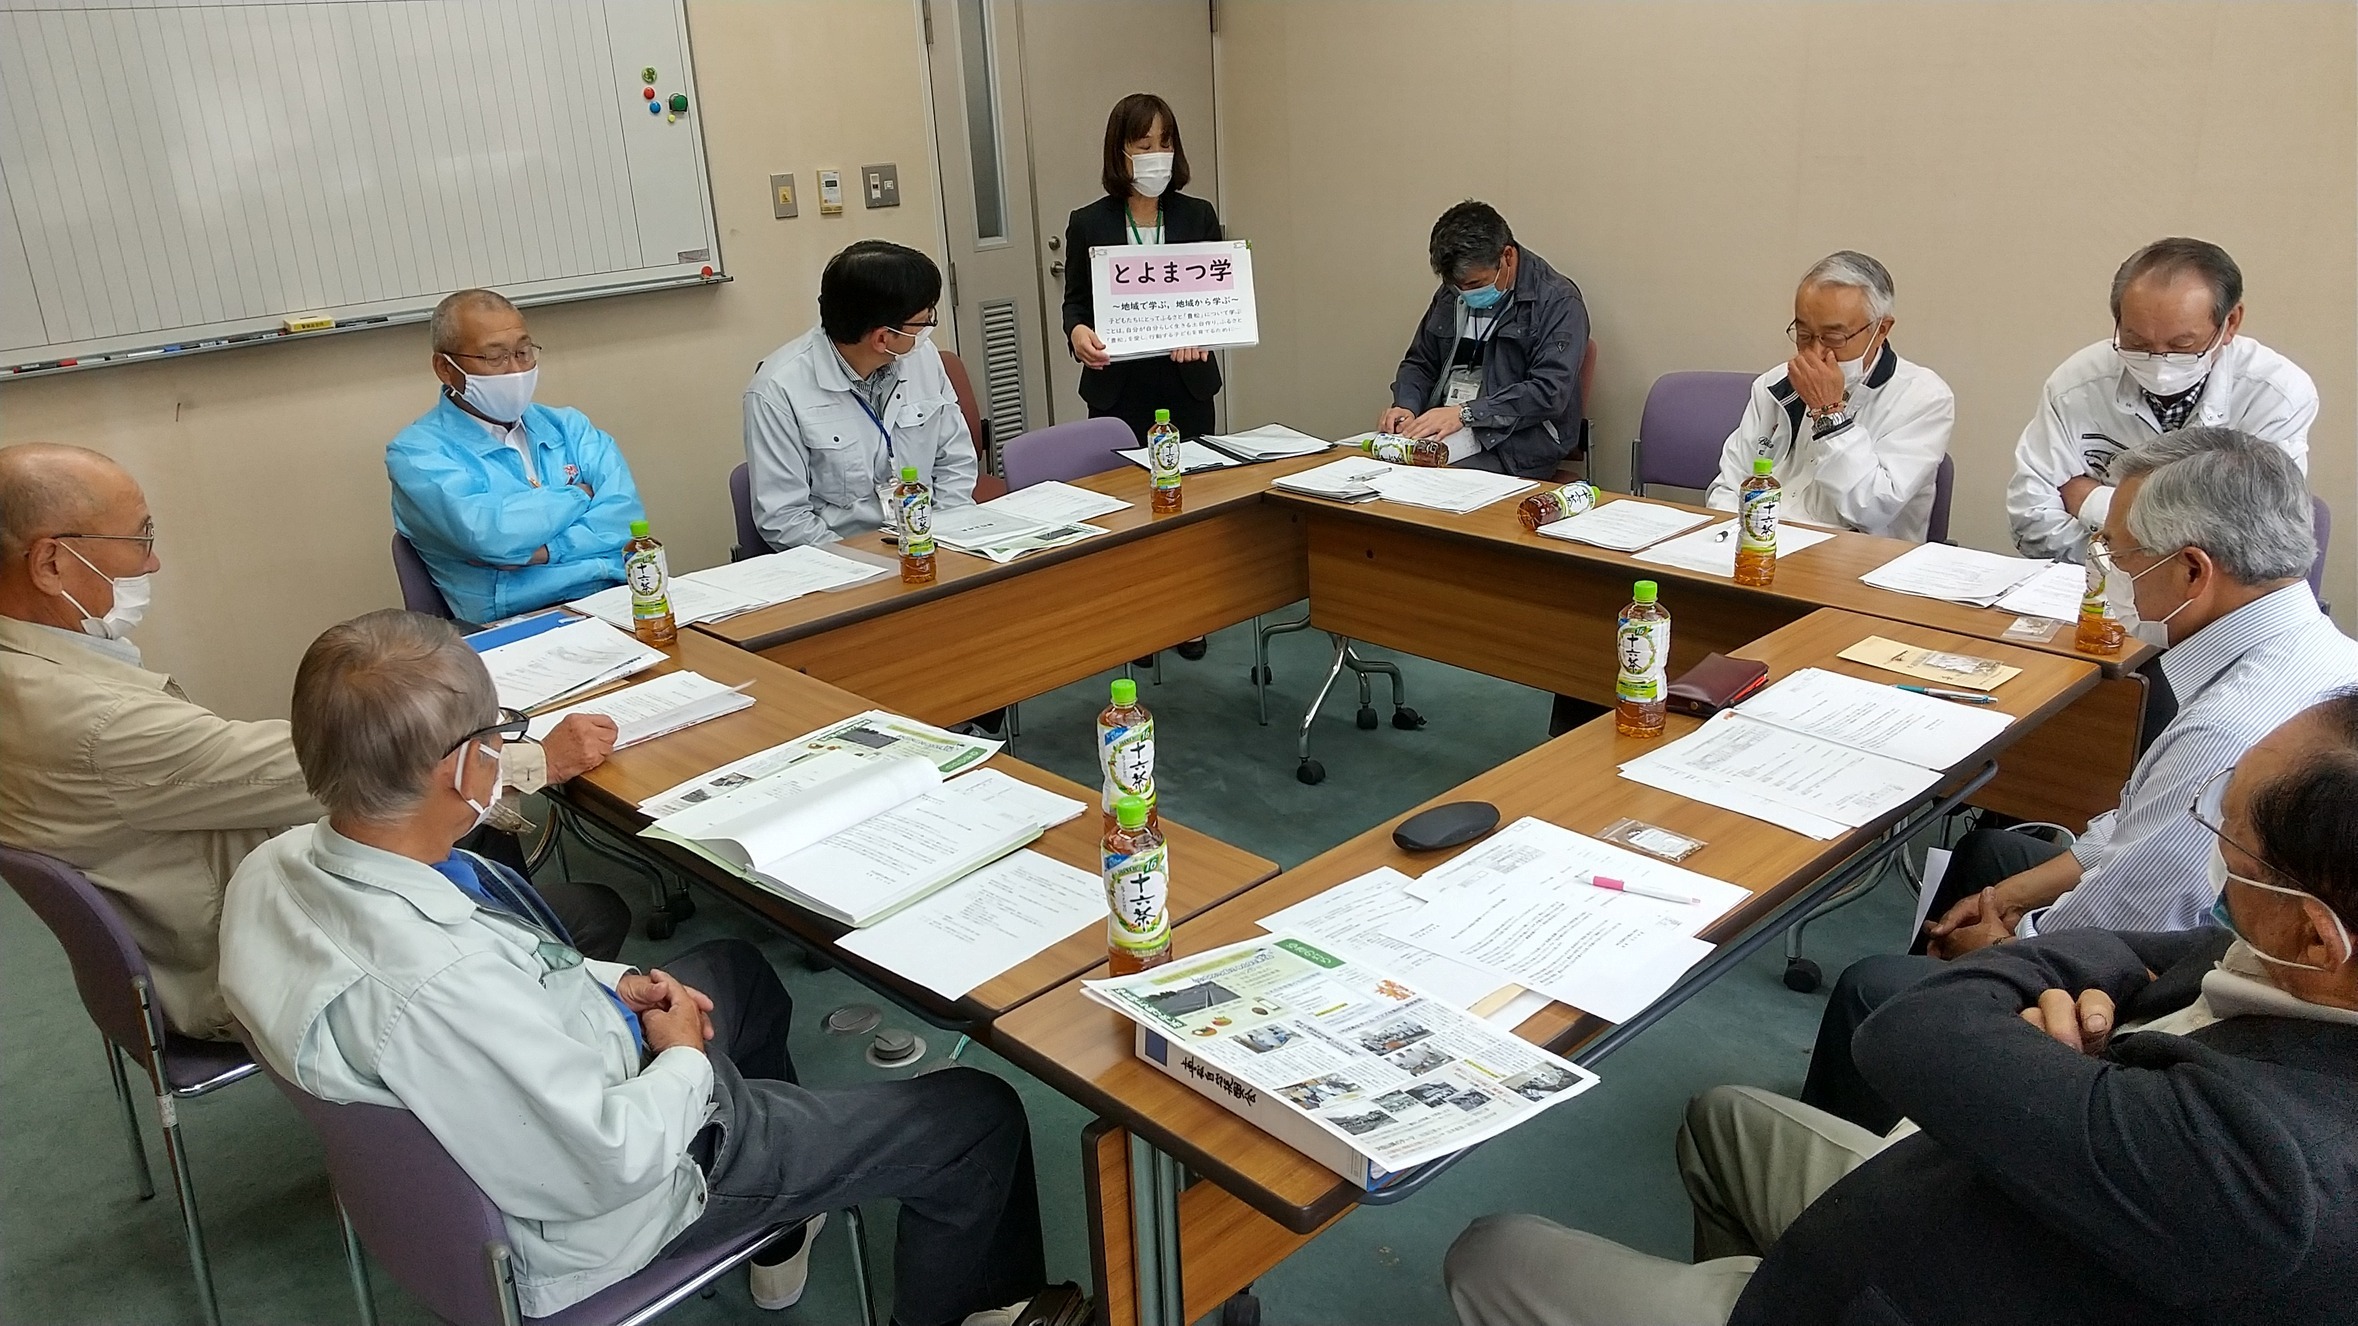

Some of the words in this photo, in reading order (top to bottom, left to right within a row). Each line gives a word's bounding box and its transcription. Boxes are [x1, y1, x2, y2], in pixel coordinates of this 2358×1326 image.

[1114, 258, 1232, 284] とよまつ学
[1760, 502, 1776, 541] 十六茶
[637, 563, 653, 595] 十六茶
[1626, 634, 1642, 673] 十六茶
[1141, 729, 1150, 740] 16
[1130, 742, 1149, 793] 十六茶
[1145, 859, 1157, 872] 16
[1129, 873, 1156, 932] 十六茶
